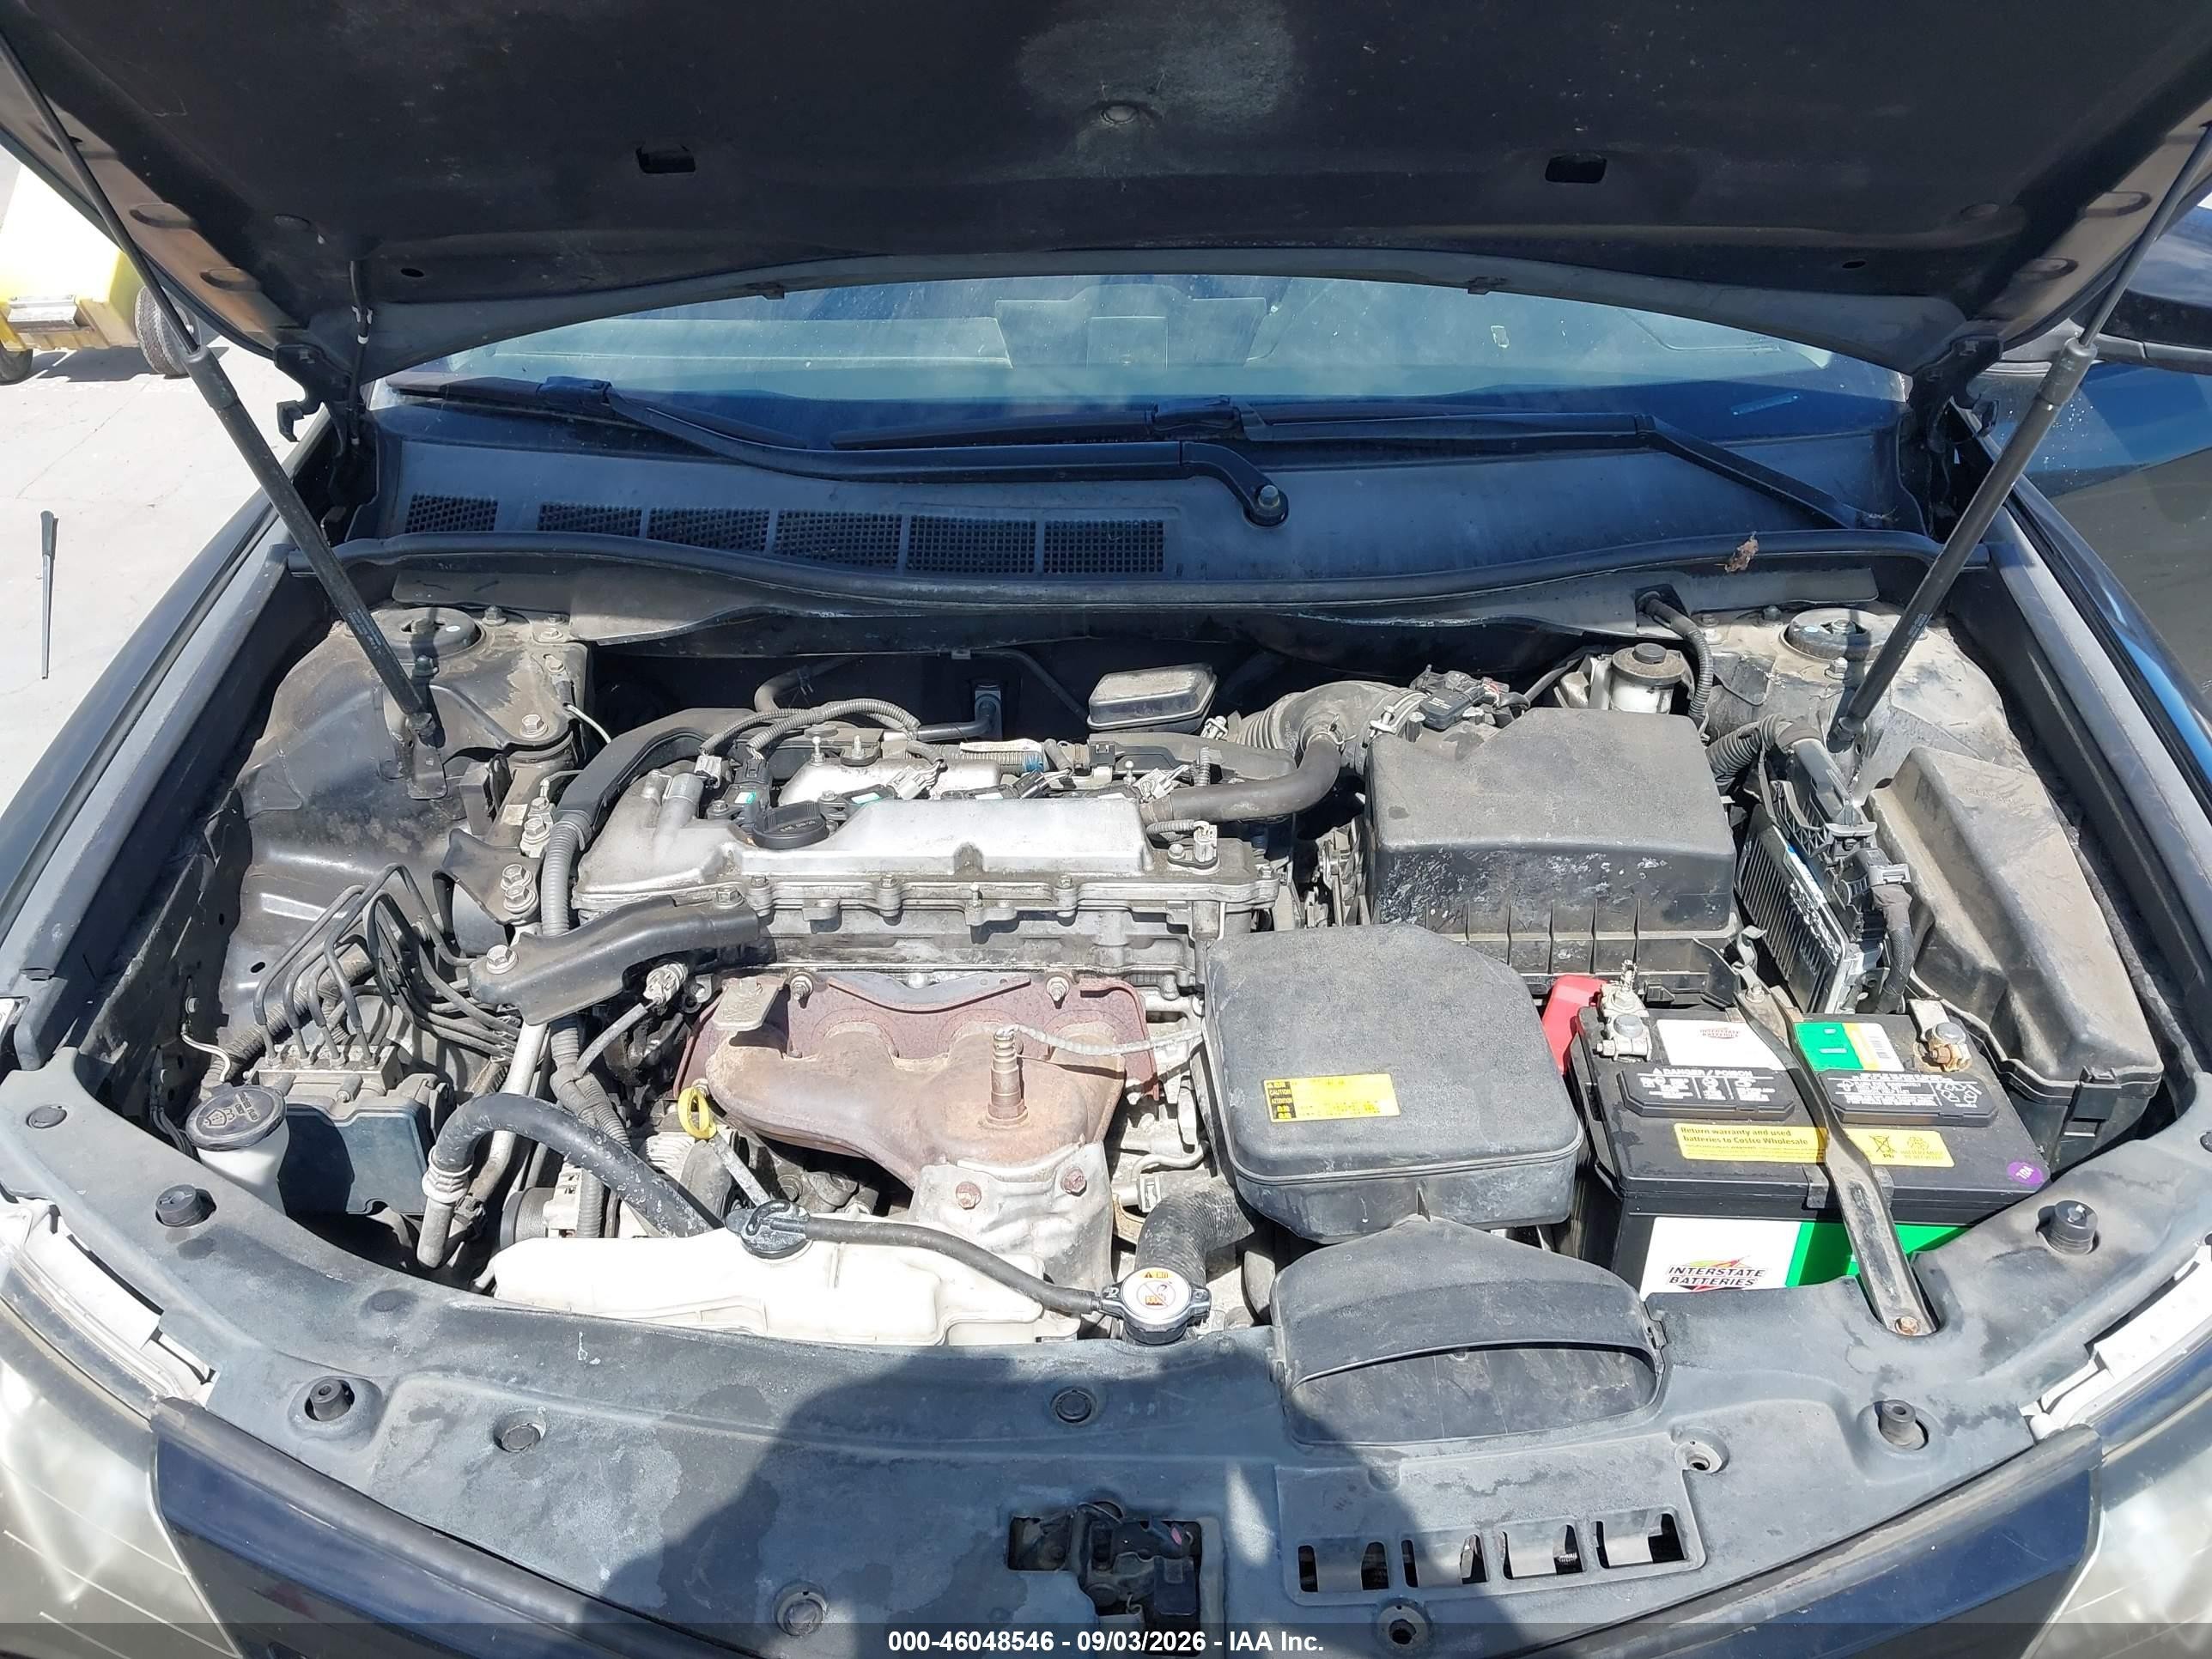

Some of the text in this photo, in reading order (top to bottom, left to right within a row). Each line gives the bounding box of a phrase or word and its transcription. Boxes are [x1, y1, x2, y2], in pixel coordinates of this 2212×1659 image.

[1763, 1137, 1808, 1146] Wholesale
[1668, 1267, 1766, 1278] INTERSTATE
[1668, 1276, 1756, 1286] BATTERIES
